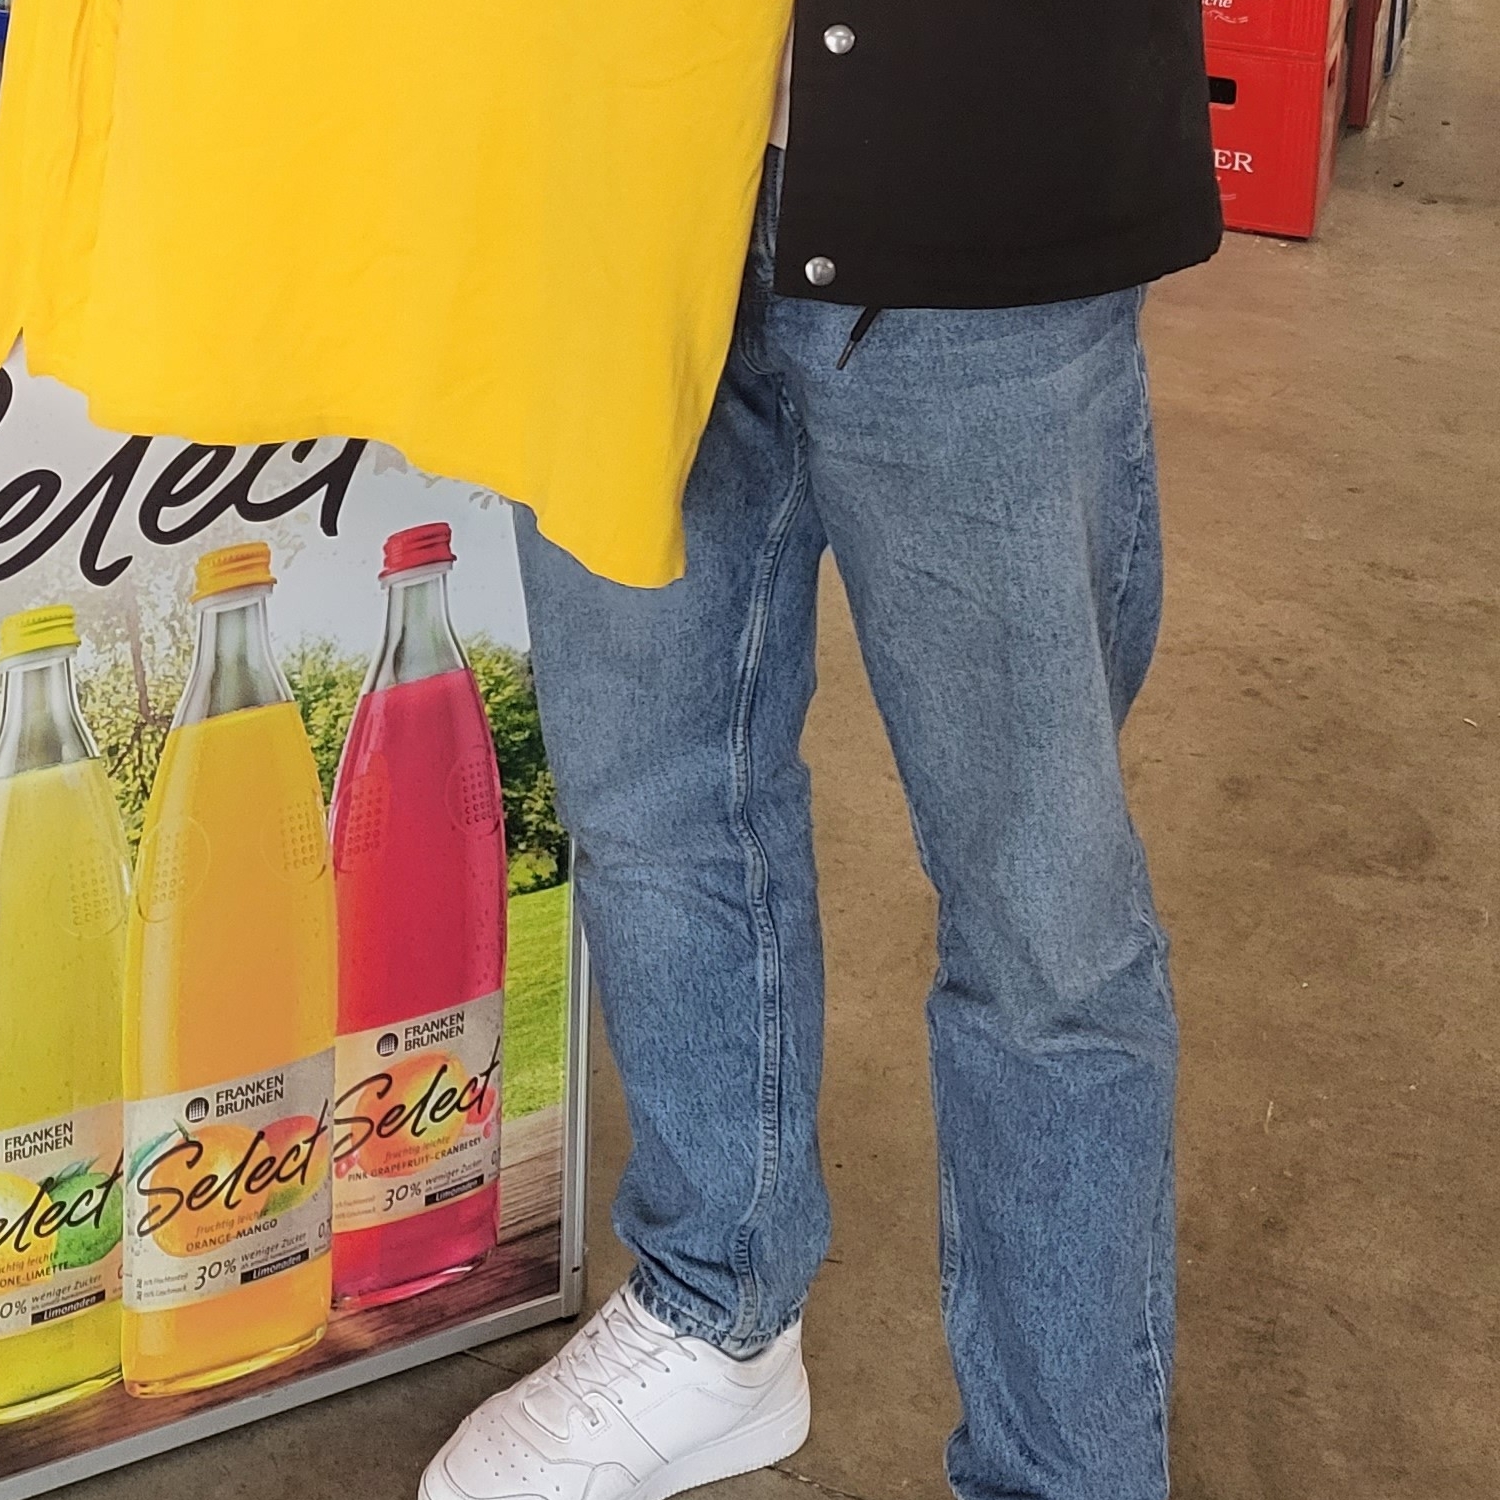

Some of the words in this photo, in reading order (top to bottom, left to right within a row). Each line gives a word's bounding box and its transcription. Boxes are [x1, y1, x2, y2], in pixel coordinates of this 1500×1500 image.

[404, 1011, 465, 1040] FRANKEN
[404, 1024, 465, 1052] BRUNNEN
[216, 1073, 284, 1104] FRANKEN
[216, 1087, 284, 1117] BRUNNEN
[334, 1035, 500, 1162] Select
[4, 1121, 73, 1150] FRANKEN
[4, 1134, 73, 1164] BRUNNEN
[137, 1098, 328, 1237] Select
[348, 1172, 368, 1183] PINK
[383, 1182, 422, 1212] 30%
[186, 1218, 278, 1252] ORANGE-MANGO
[195, 1220, 235, 1238] fruchtig
[194, 1258, 237, 1290] 30%
[240, 1243, 280, 1262] weniger
[252, 1255, 301, 1280] Limonaden
[31, 1286, 71, 1303] weniger
[73, 1274, 102, 1290] Zucker
[43, 1294, 97, 1321] Limonaden
